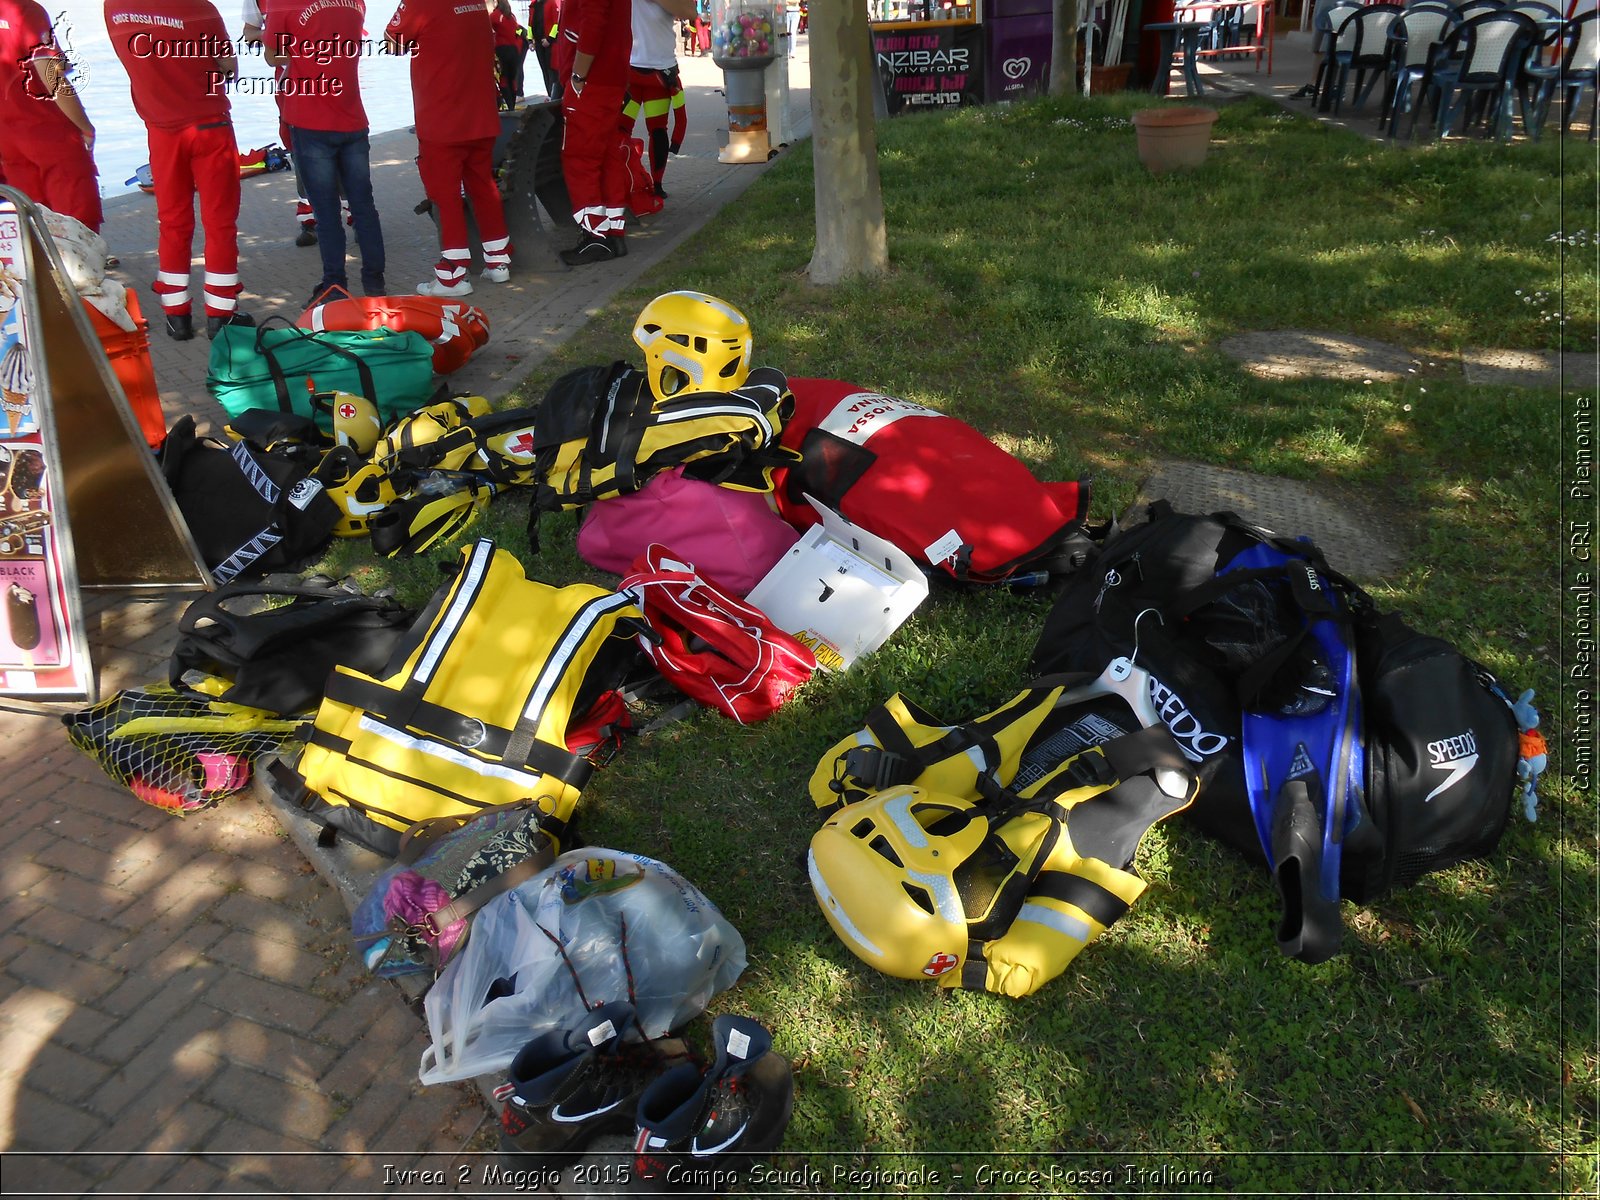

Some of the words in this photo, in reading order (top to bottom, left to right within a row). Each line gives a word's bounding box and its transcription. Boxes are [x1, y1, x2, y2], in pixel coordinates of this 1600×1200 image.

[130, 13, 152, 25] ROSSA
[153, 15, 185, 30] ITALIANA
[298, 2, 321, 26] CROCE
[894, 64, 969, 74] viverone
[902, 92, 961, 105] TECHNO
[848, 405, 894, 434] ROSSA
[1426, 732, 1477, 764] SPEEDO
